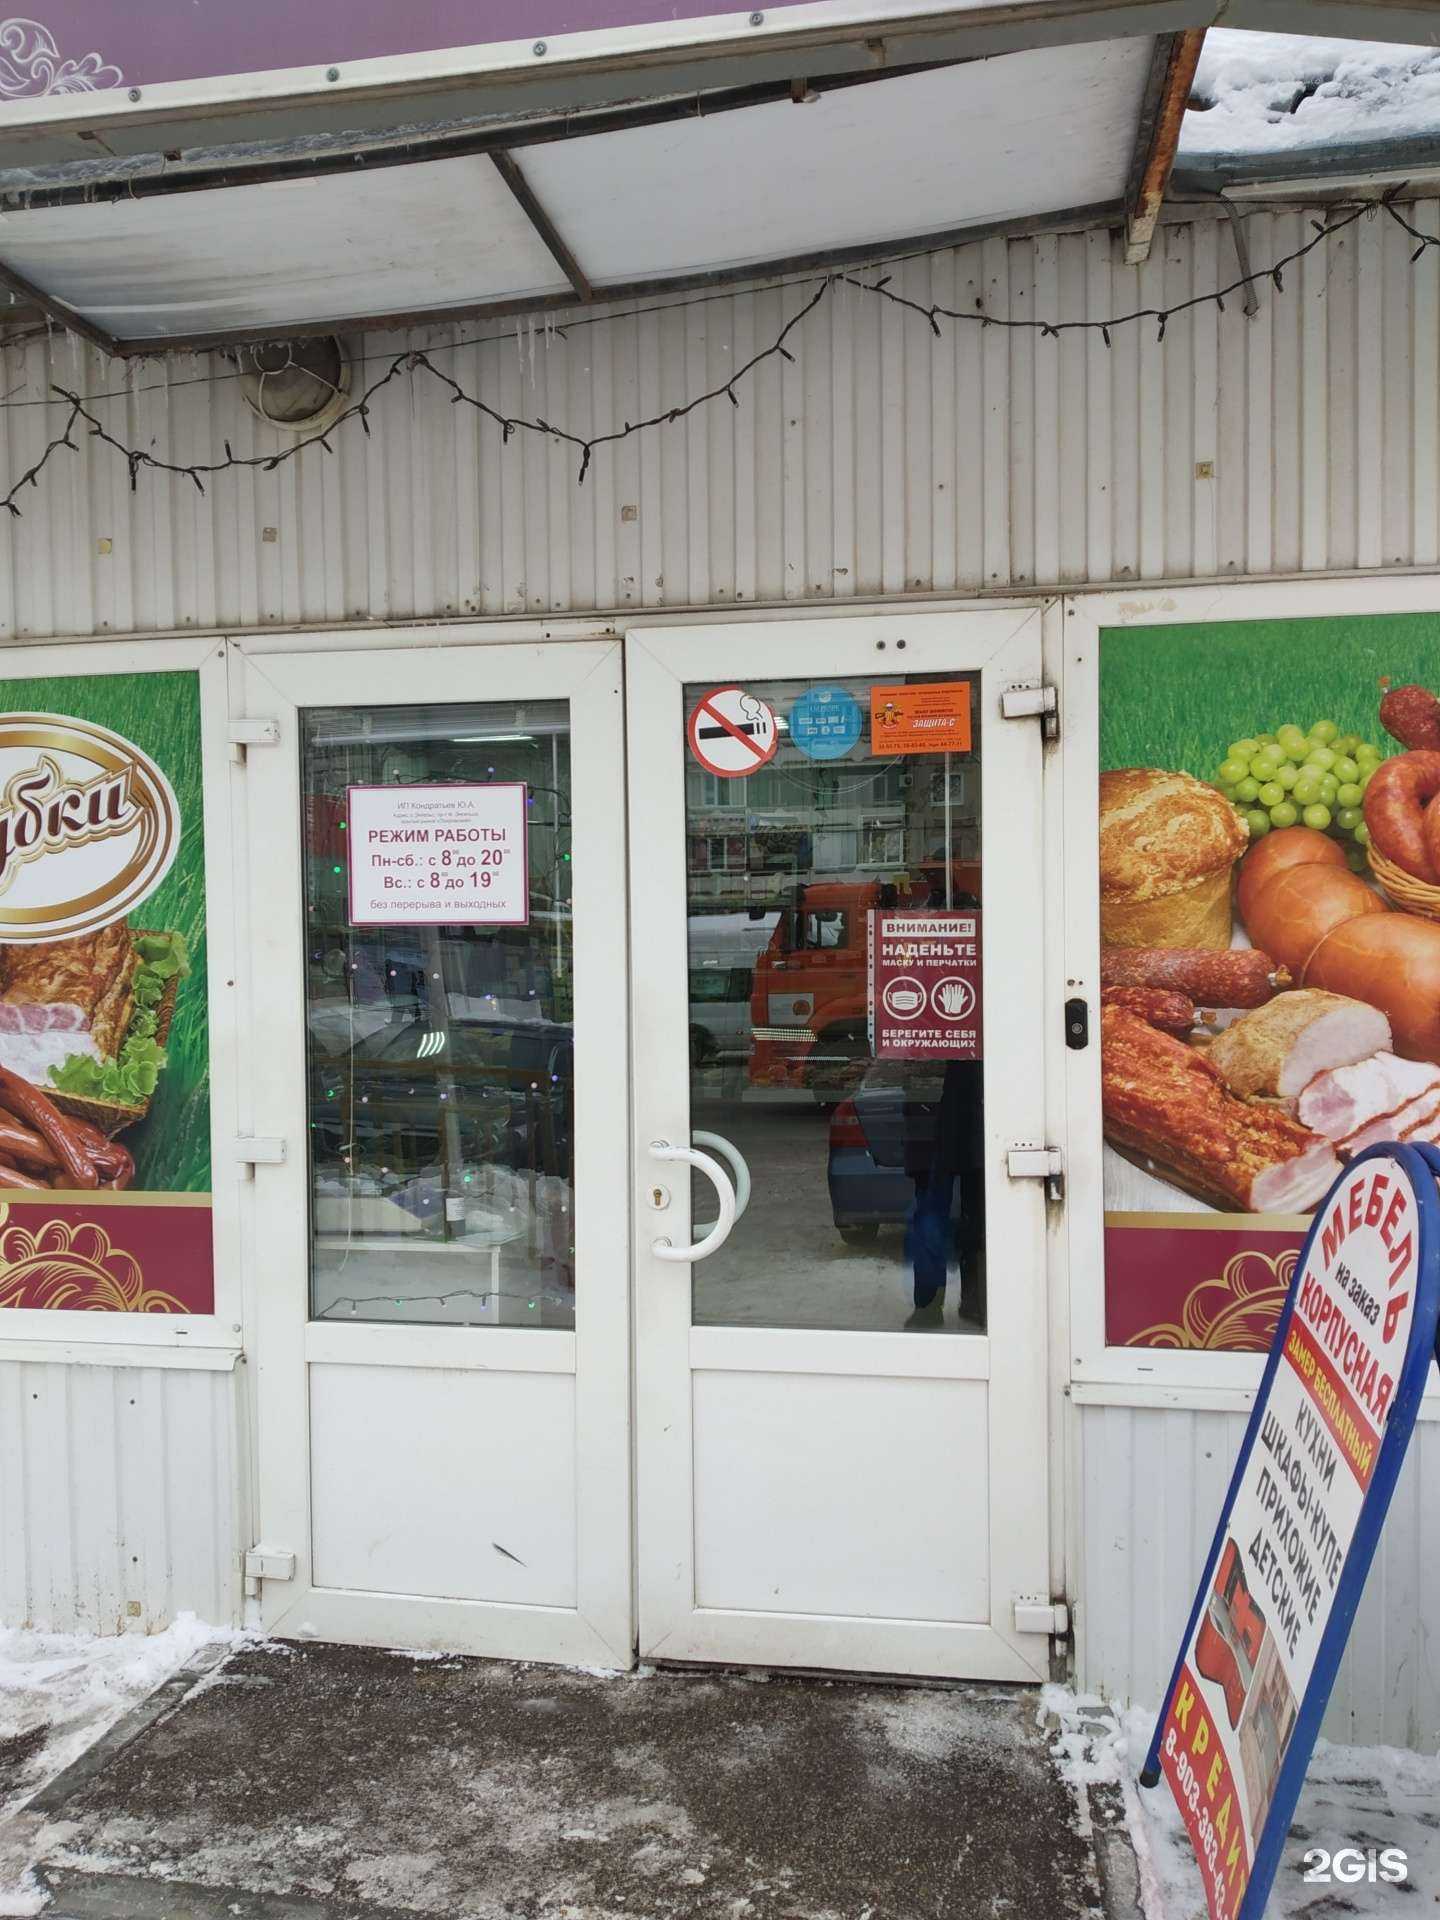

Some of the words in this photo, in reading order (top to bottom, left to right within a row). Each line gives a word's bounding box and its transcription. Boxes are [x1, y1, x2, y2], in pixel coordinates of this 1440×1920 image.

[368, 830, 429, 843] РЕЖИМ
[434, 828, 506, 842] РАБОТЫ
[371, 853, 424, 867] Пн-сб.:
[428, 857, 436, 866] с
[457, 856, 476, 868] до
[384, 876, 412, 889] Вс.:
[417, 879, 425, 888] с
[445, 878, 464, 890] до
[370, 900, 388, 910] без
[391, 901, 441, 911] перерыва
[454, 900, 506, 911] выходных
[886, 923, 972, 933] ВНИМАНИЕ!
[882, 944, 977, 957] НАДЕНЬТЕ
[882, 959, 914, 967] МАСКУ
[926, 959, 977, 967] ПЕРЧАТКИ
[882, 1029, 942, 1038] БЕРЕГИТЕ
[945, 1029, 976, 1038] СЕБЯ
[893, 1039, 976, 1049] ОКРУЖАЮЩИХ
[1321, 1173, 1413, 1345] МЕБЕЛЬ
[1335, 1260, 1351, 1292] на
[1347, 1276, 1381, 1327] заказ
[1299, 1271, 1394, 1426] КОРПУСНАЯ
[1287, 1329, 1317, 1378] ЗАМЕР
[1313, 1366, 1374, 1480] БЕСПЛАТНЫЙ
[1294, 1398, 1337, 1492] КУХНИ
[1260, 1410, 1342, 1590] ШКАФЫ-КУПЕ
[1256, 1465, 1322, 1626] ПРИХОЖИЕ
[1248, 1527, 1301, 1660] ДЕТСКИЕ
